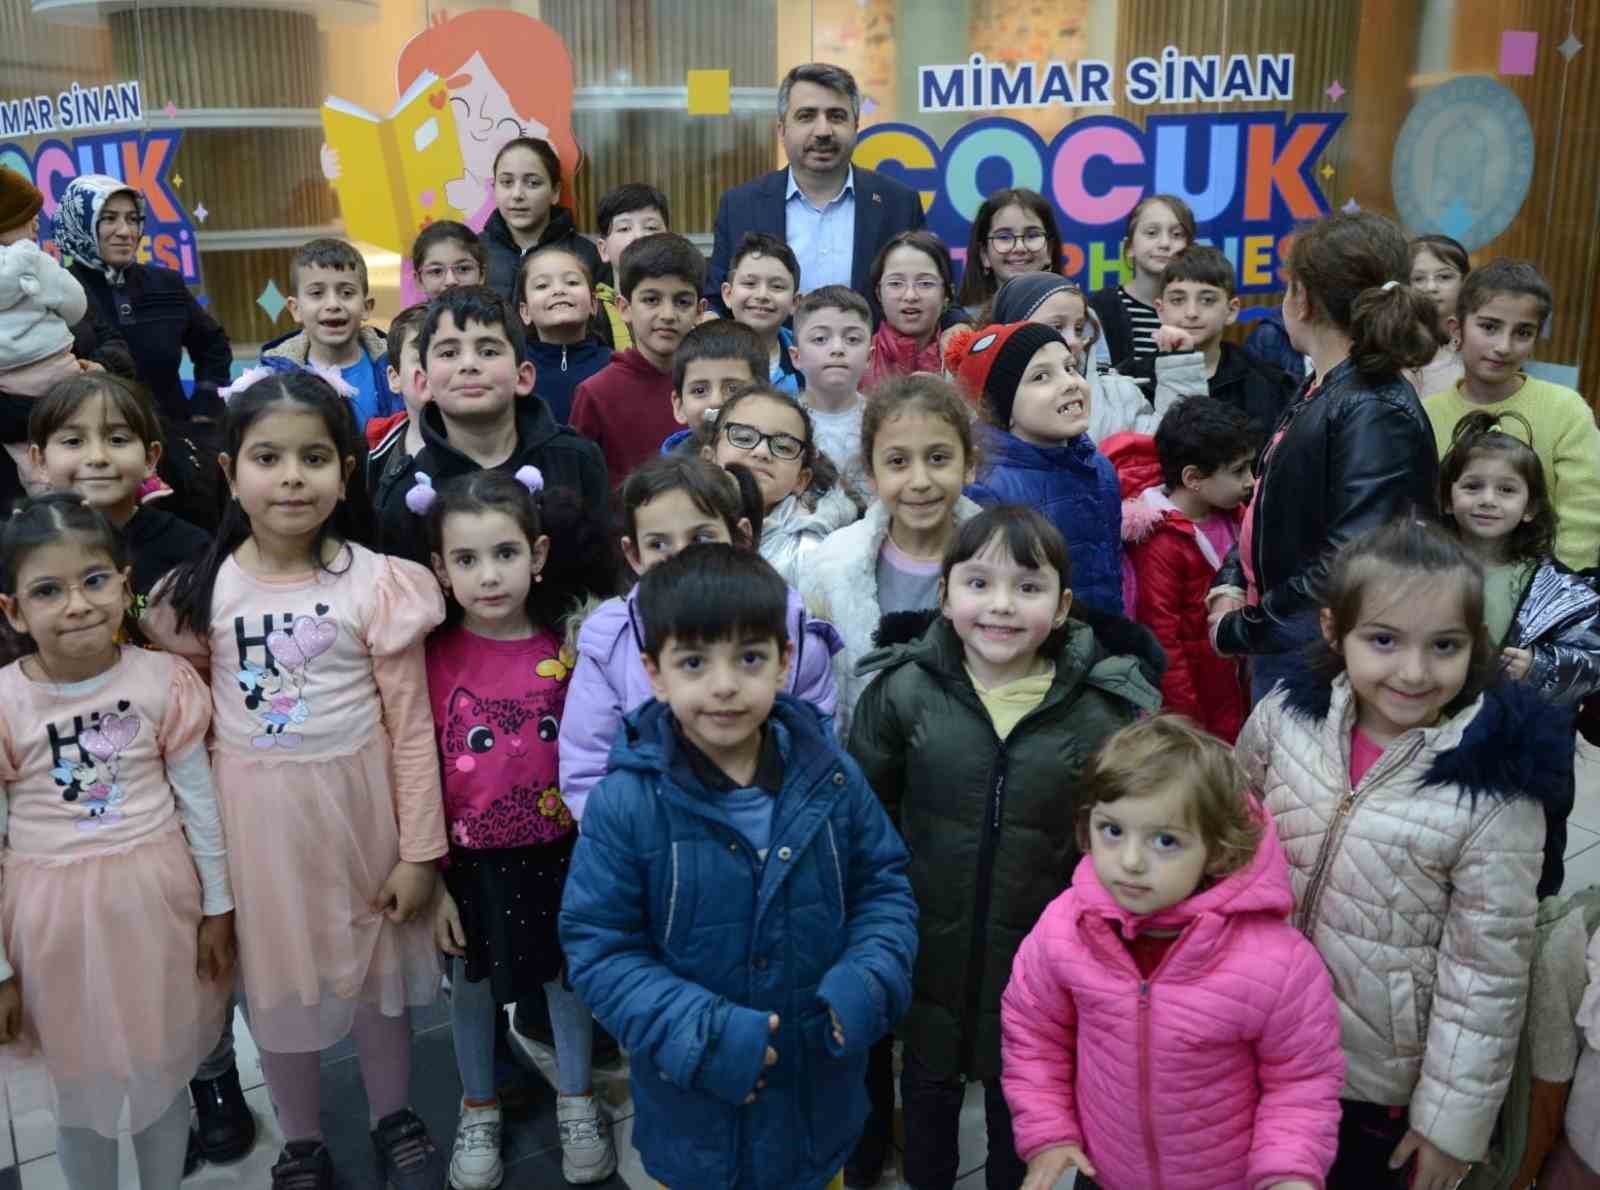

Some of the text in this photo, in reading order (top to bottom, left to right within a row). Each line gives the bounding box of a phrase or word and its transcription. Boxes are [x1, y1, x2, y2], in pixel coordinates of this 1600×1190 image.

[921, 47, 1292, 109] MİMAR SİNAN
[0, 84, 140, 134] MAR SİNAN
